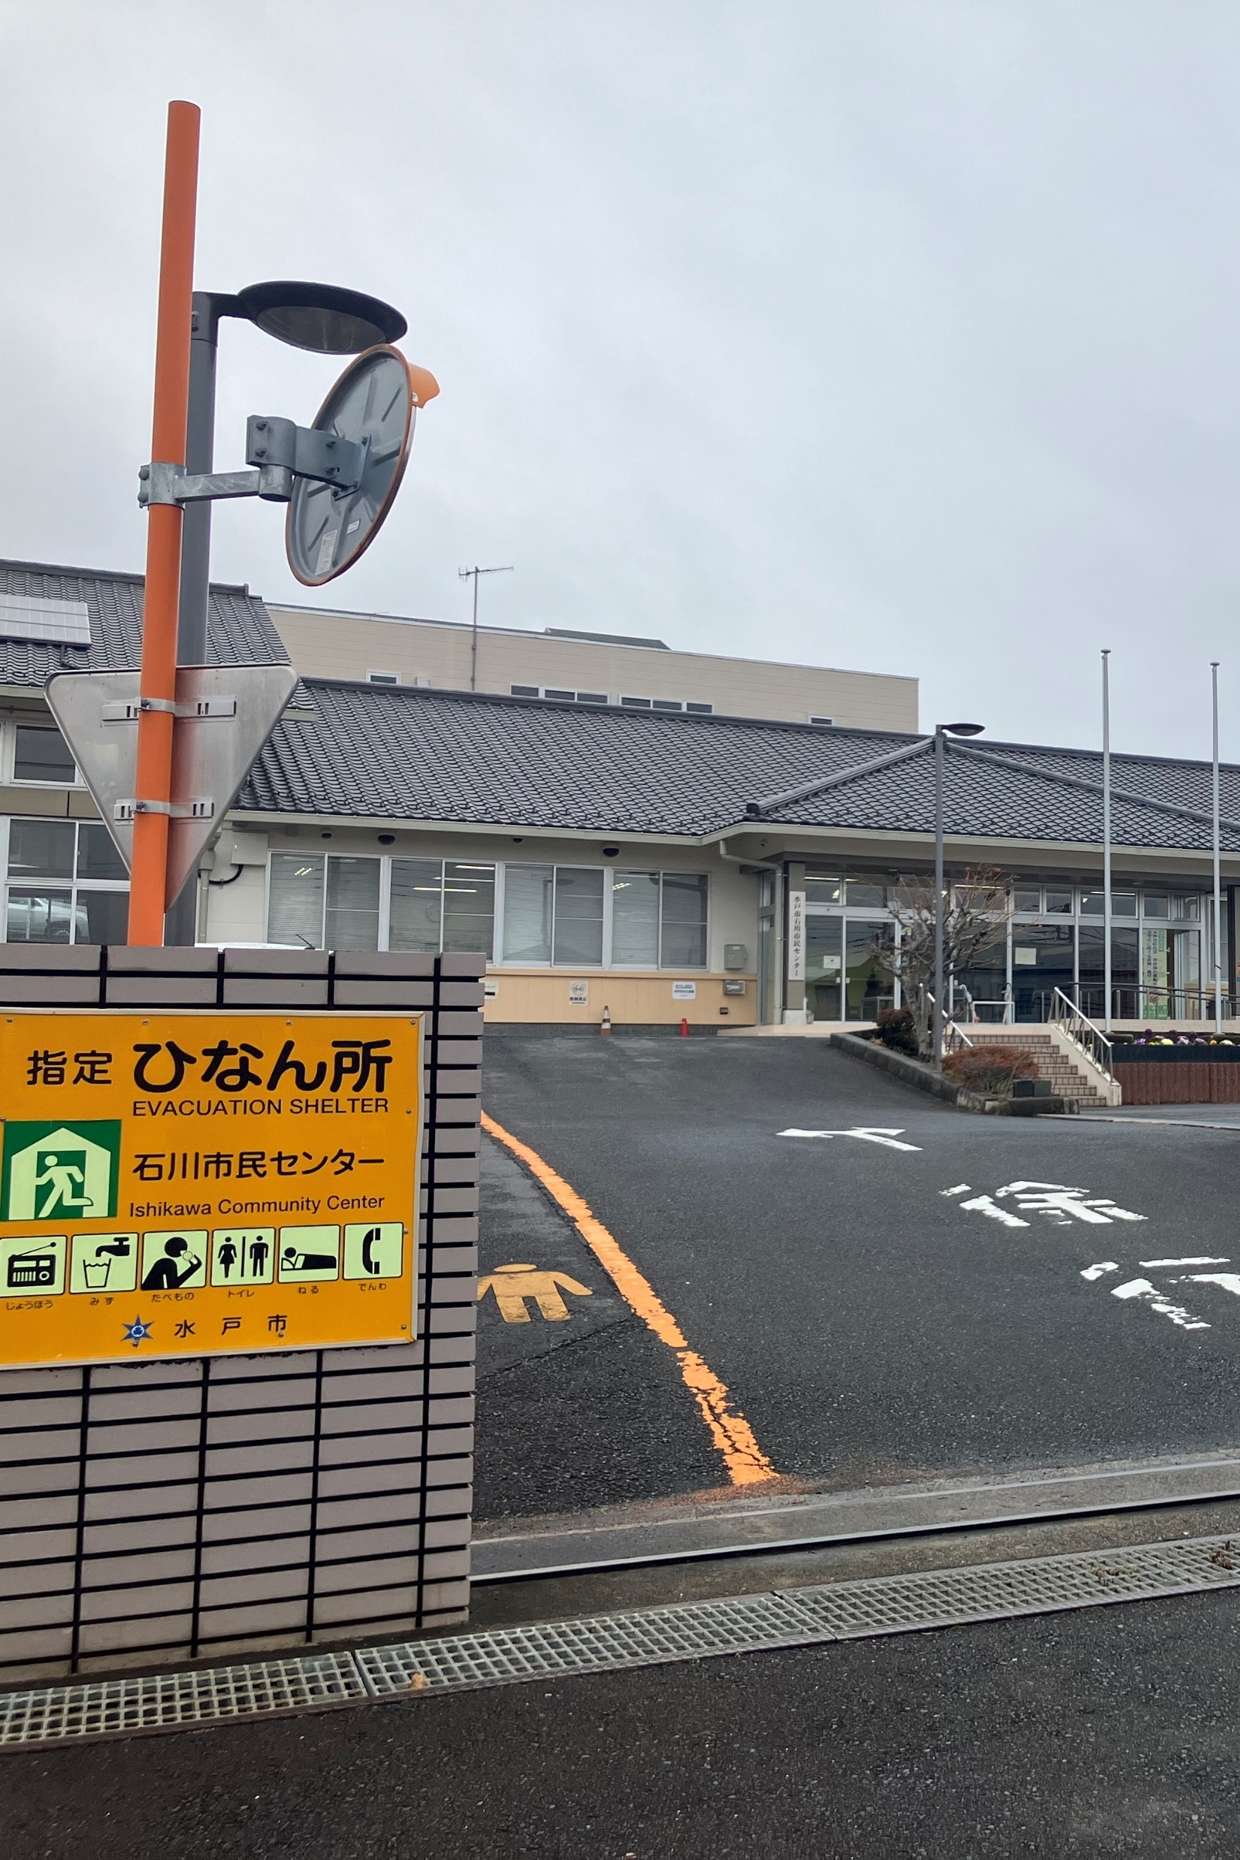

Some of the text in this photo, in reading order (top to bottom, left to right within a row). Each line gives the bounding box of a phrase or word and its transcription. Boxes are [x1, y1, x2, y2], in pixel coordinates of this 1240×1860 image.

[793, 896, 802, 976] 水戸市石川市民センター
[27, 1038, 393, 1094] 指定 ひなん所
[132, 1097, 389, 1117] EVACUATION SHELTER
[132, 1149, 385, 1181] 石川市民センター
[129, 1195, 385, 1217] Ishikawa Community Center
[227, 1288, 255, 1299] トイレ
[297, 1285, 319, 1295] ねる
[358, 1282, 387, 1292] でんわ
[6, 1299, 54, 1311] じょうほう
[90, 1296, 115, 1306] みず
[151, 1291, 195, 1303] たべもの
[174, 1314, 288, 1338] 水戸市
